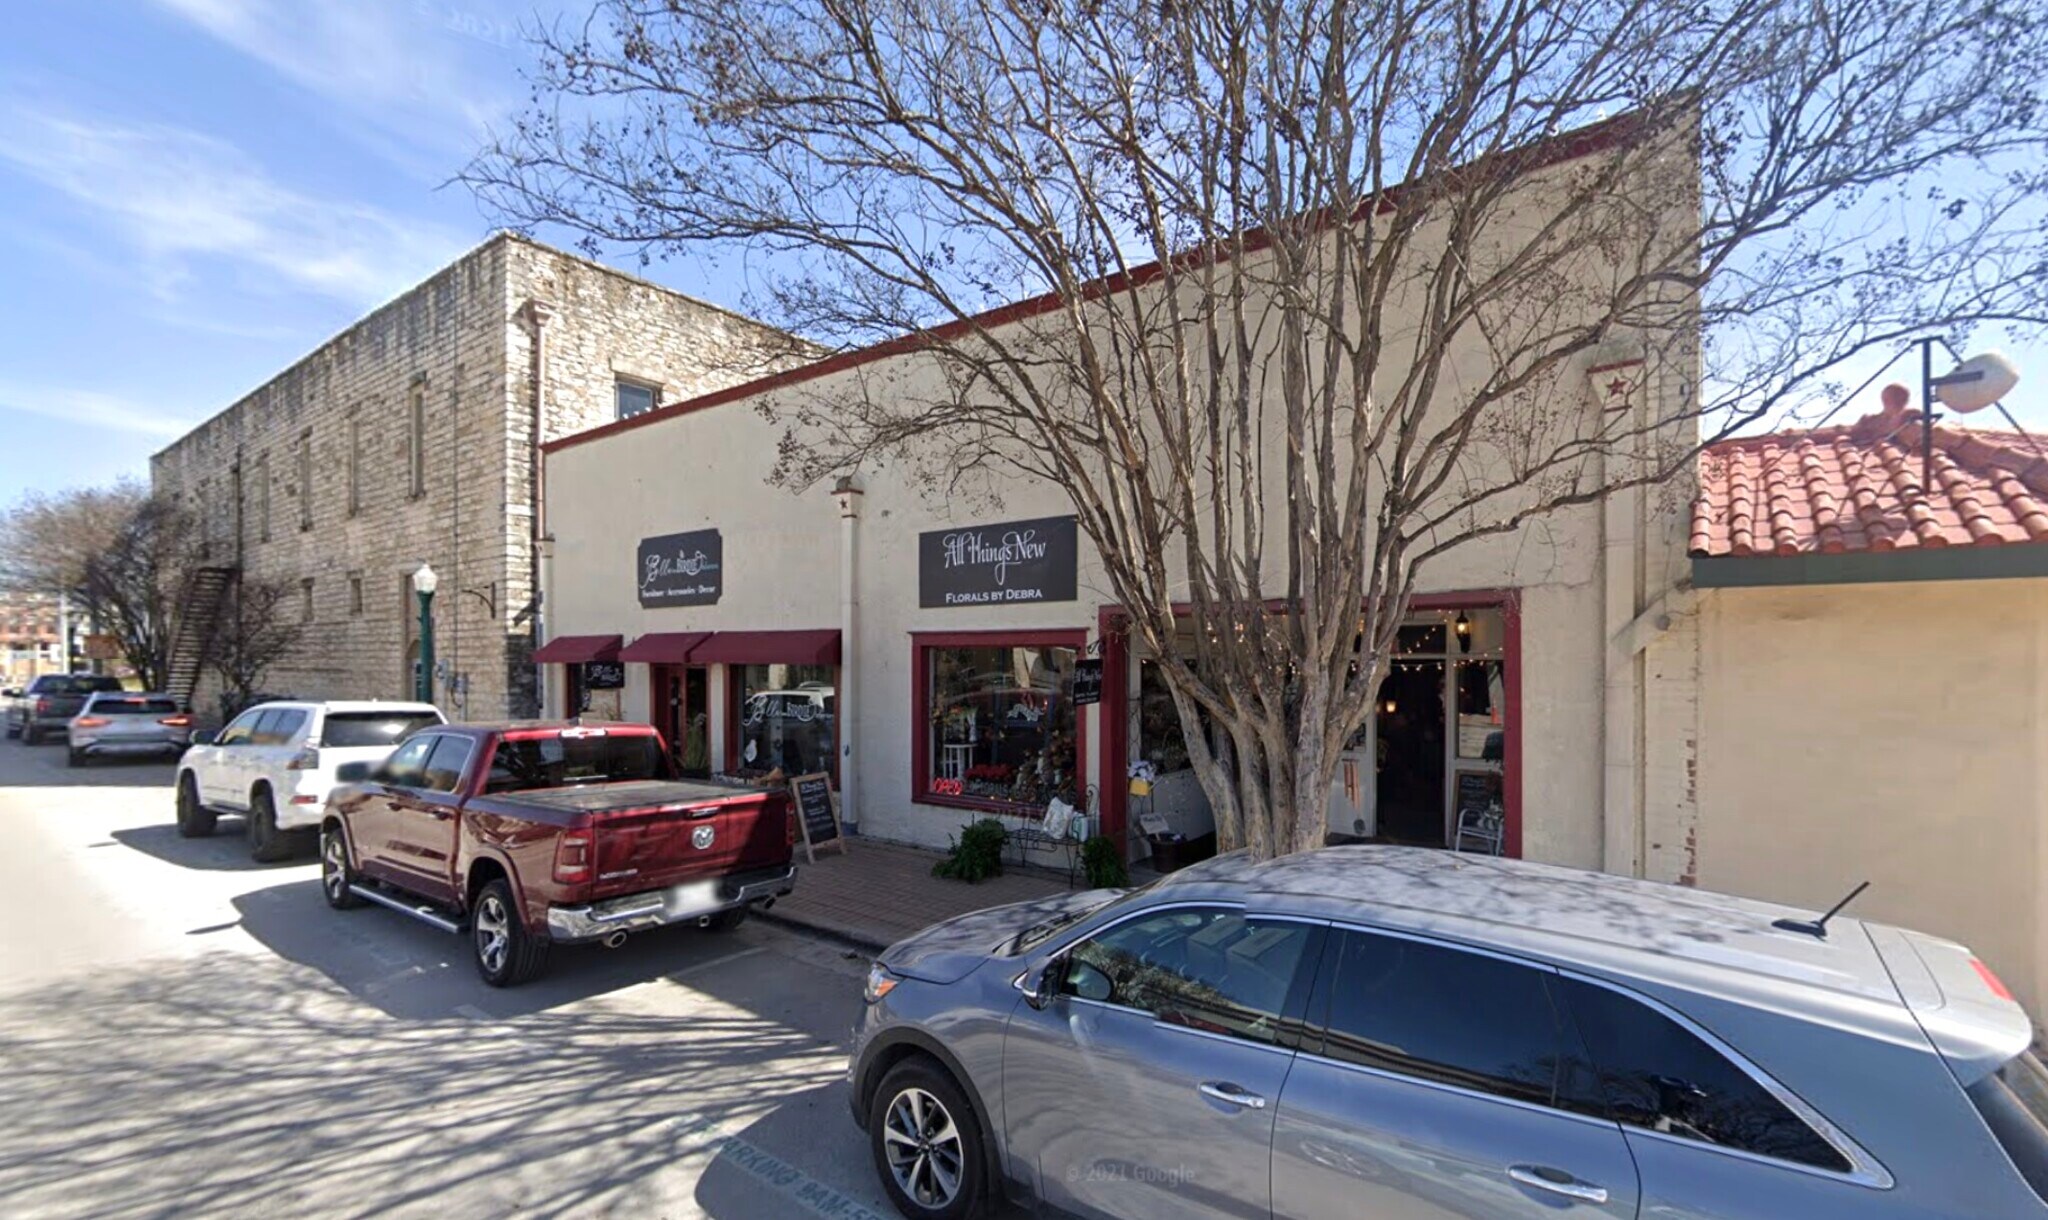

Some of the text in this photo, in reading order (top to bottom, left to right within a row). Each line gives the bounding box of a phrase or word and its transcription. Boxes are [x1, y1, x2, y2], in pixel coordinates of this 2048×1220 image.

[943, 529, 1046, 585] All Things New
[945, 588, 1043, 604] FLORALS BY DEBRA
[933, 777, 962, 796] OPEN
